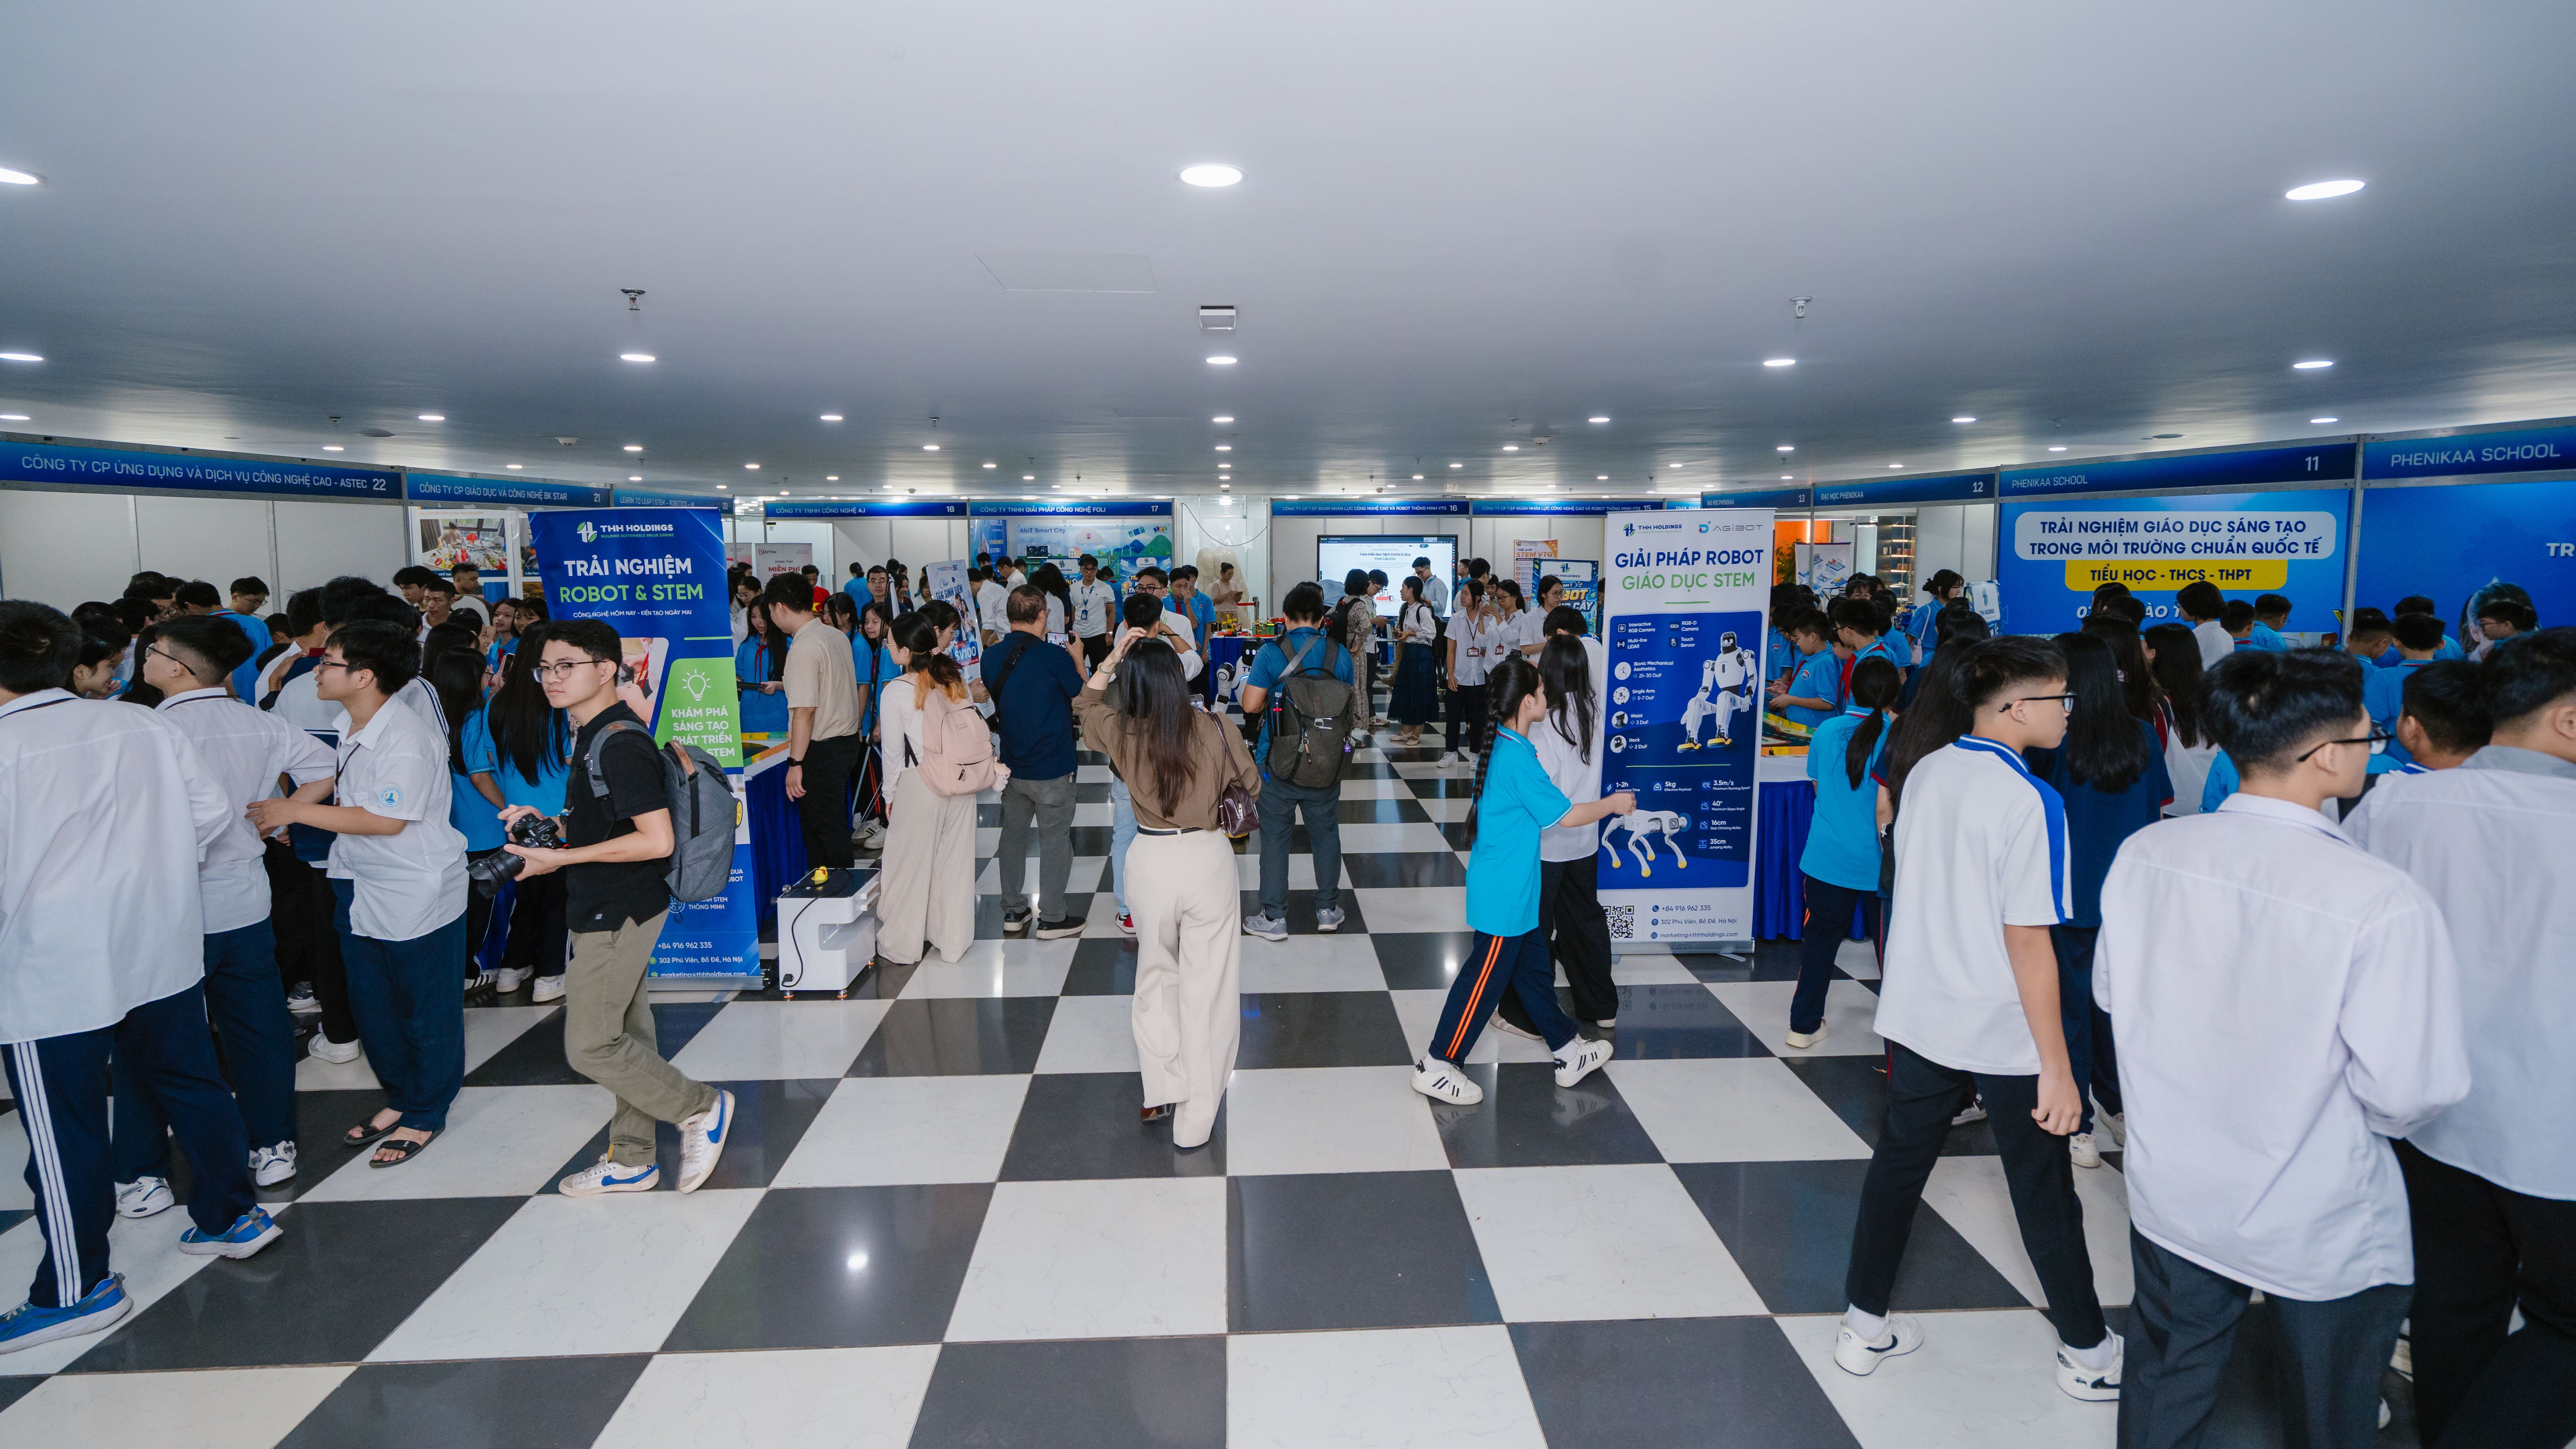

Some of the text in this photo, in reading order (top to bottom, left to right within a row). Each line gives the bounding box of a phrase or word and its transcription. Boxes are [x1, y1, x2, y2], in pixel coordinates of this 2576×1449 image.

[2391, 444, 2560, 467] PHENIKAA SCHOOL
[2306, 456, 2318, 471] 11
[22, 454, 367, 488] CÔNG TY CP ỨNG DỤNG VÀ DỊCH VỤ CÔNG NGHỆ CAO ASTEC
[373, 479, 386, 491] 22
[1973, 482, 1983, 492] 12
[2012, 475, 2088, 488] PHENIKAA SCHOOL
[594, 493, 600, 502] 21
[2040, 517, 2306, 536] TRẢI NGHIỆM GIÁO DỤC SÁNG TẠO
[2030, 535, 2322, 554] TRONG MÔI TRƯỜNG CHUẨN QUỐC TẾ
[2546, 543, 2575, 556] TR
[1615, 548, 1764, 567] GIẢI PHÁP ROBOT
[564, 554, 692, 579] TRẢI NGHIỆM
[2090, 564, 2251, 584] TIỂU HỌC THCS THPT
[1622, 571, 1755, 592] GIÁO DỤC STEM
[560, 584, 703, 602] ROBOT & STEM
[945, 588, 954, 597] SINH
[955, 646, 976, 660] SV100
[672, 705, 728, 717] KHÁM PHÁ
[673, 720, 729, 732] SÁNG TẠO
[673, 731, 732, 744] PHÁT TRIỂN
[706, 748, 734, 757] STEM
